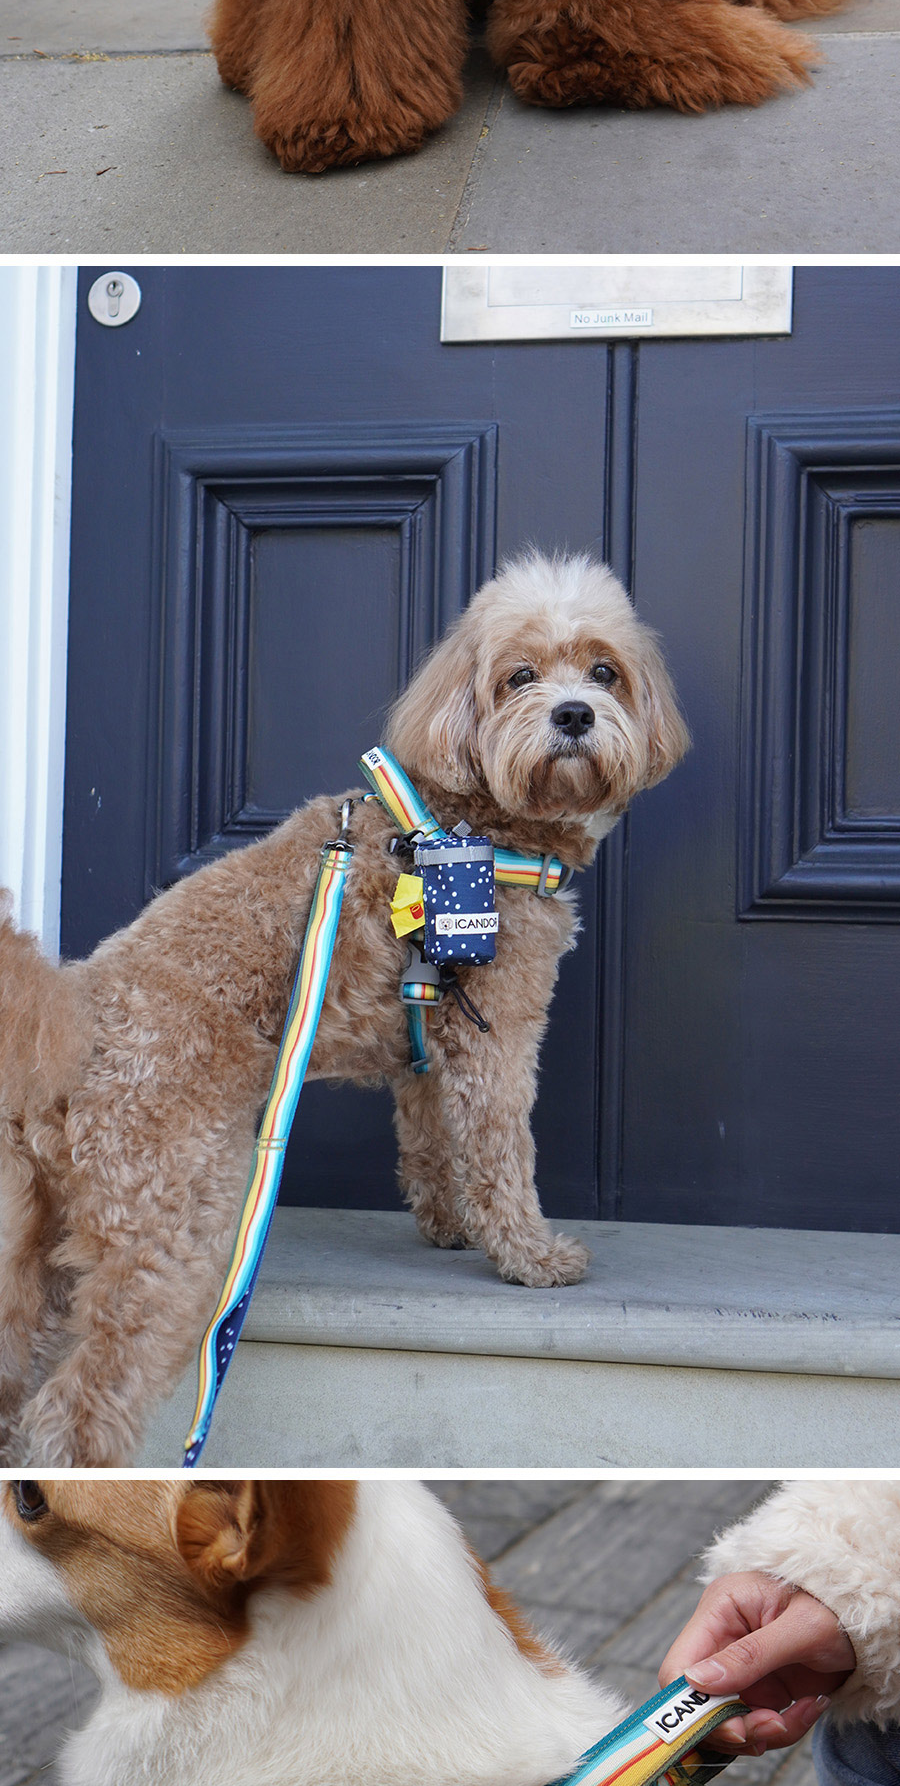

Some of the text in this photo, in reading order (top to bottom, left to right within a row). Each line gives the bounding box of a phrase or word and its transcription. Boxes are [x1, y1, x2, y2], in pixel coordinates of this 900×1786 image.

[574, 312, 648, 324] No Junk Mail
